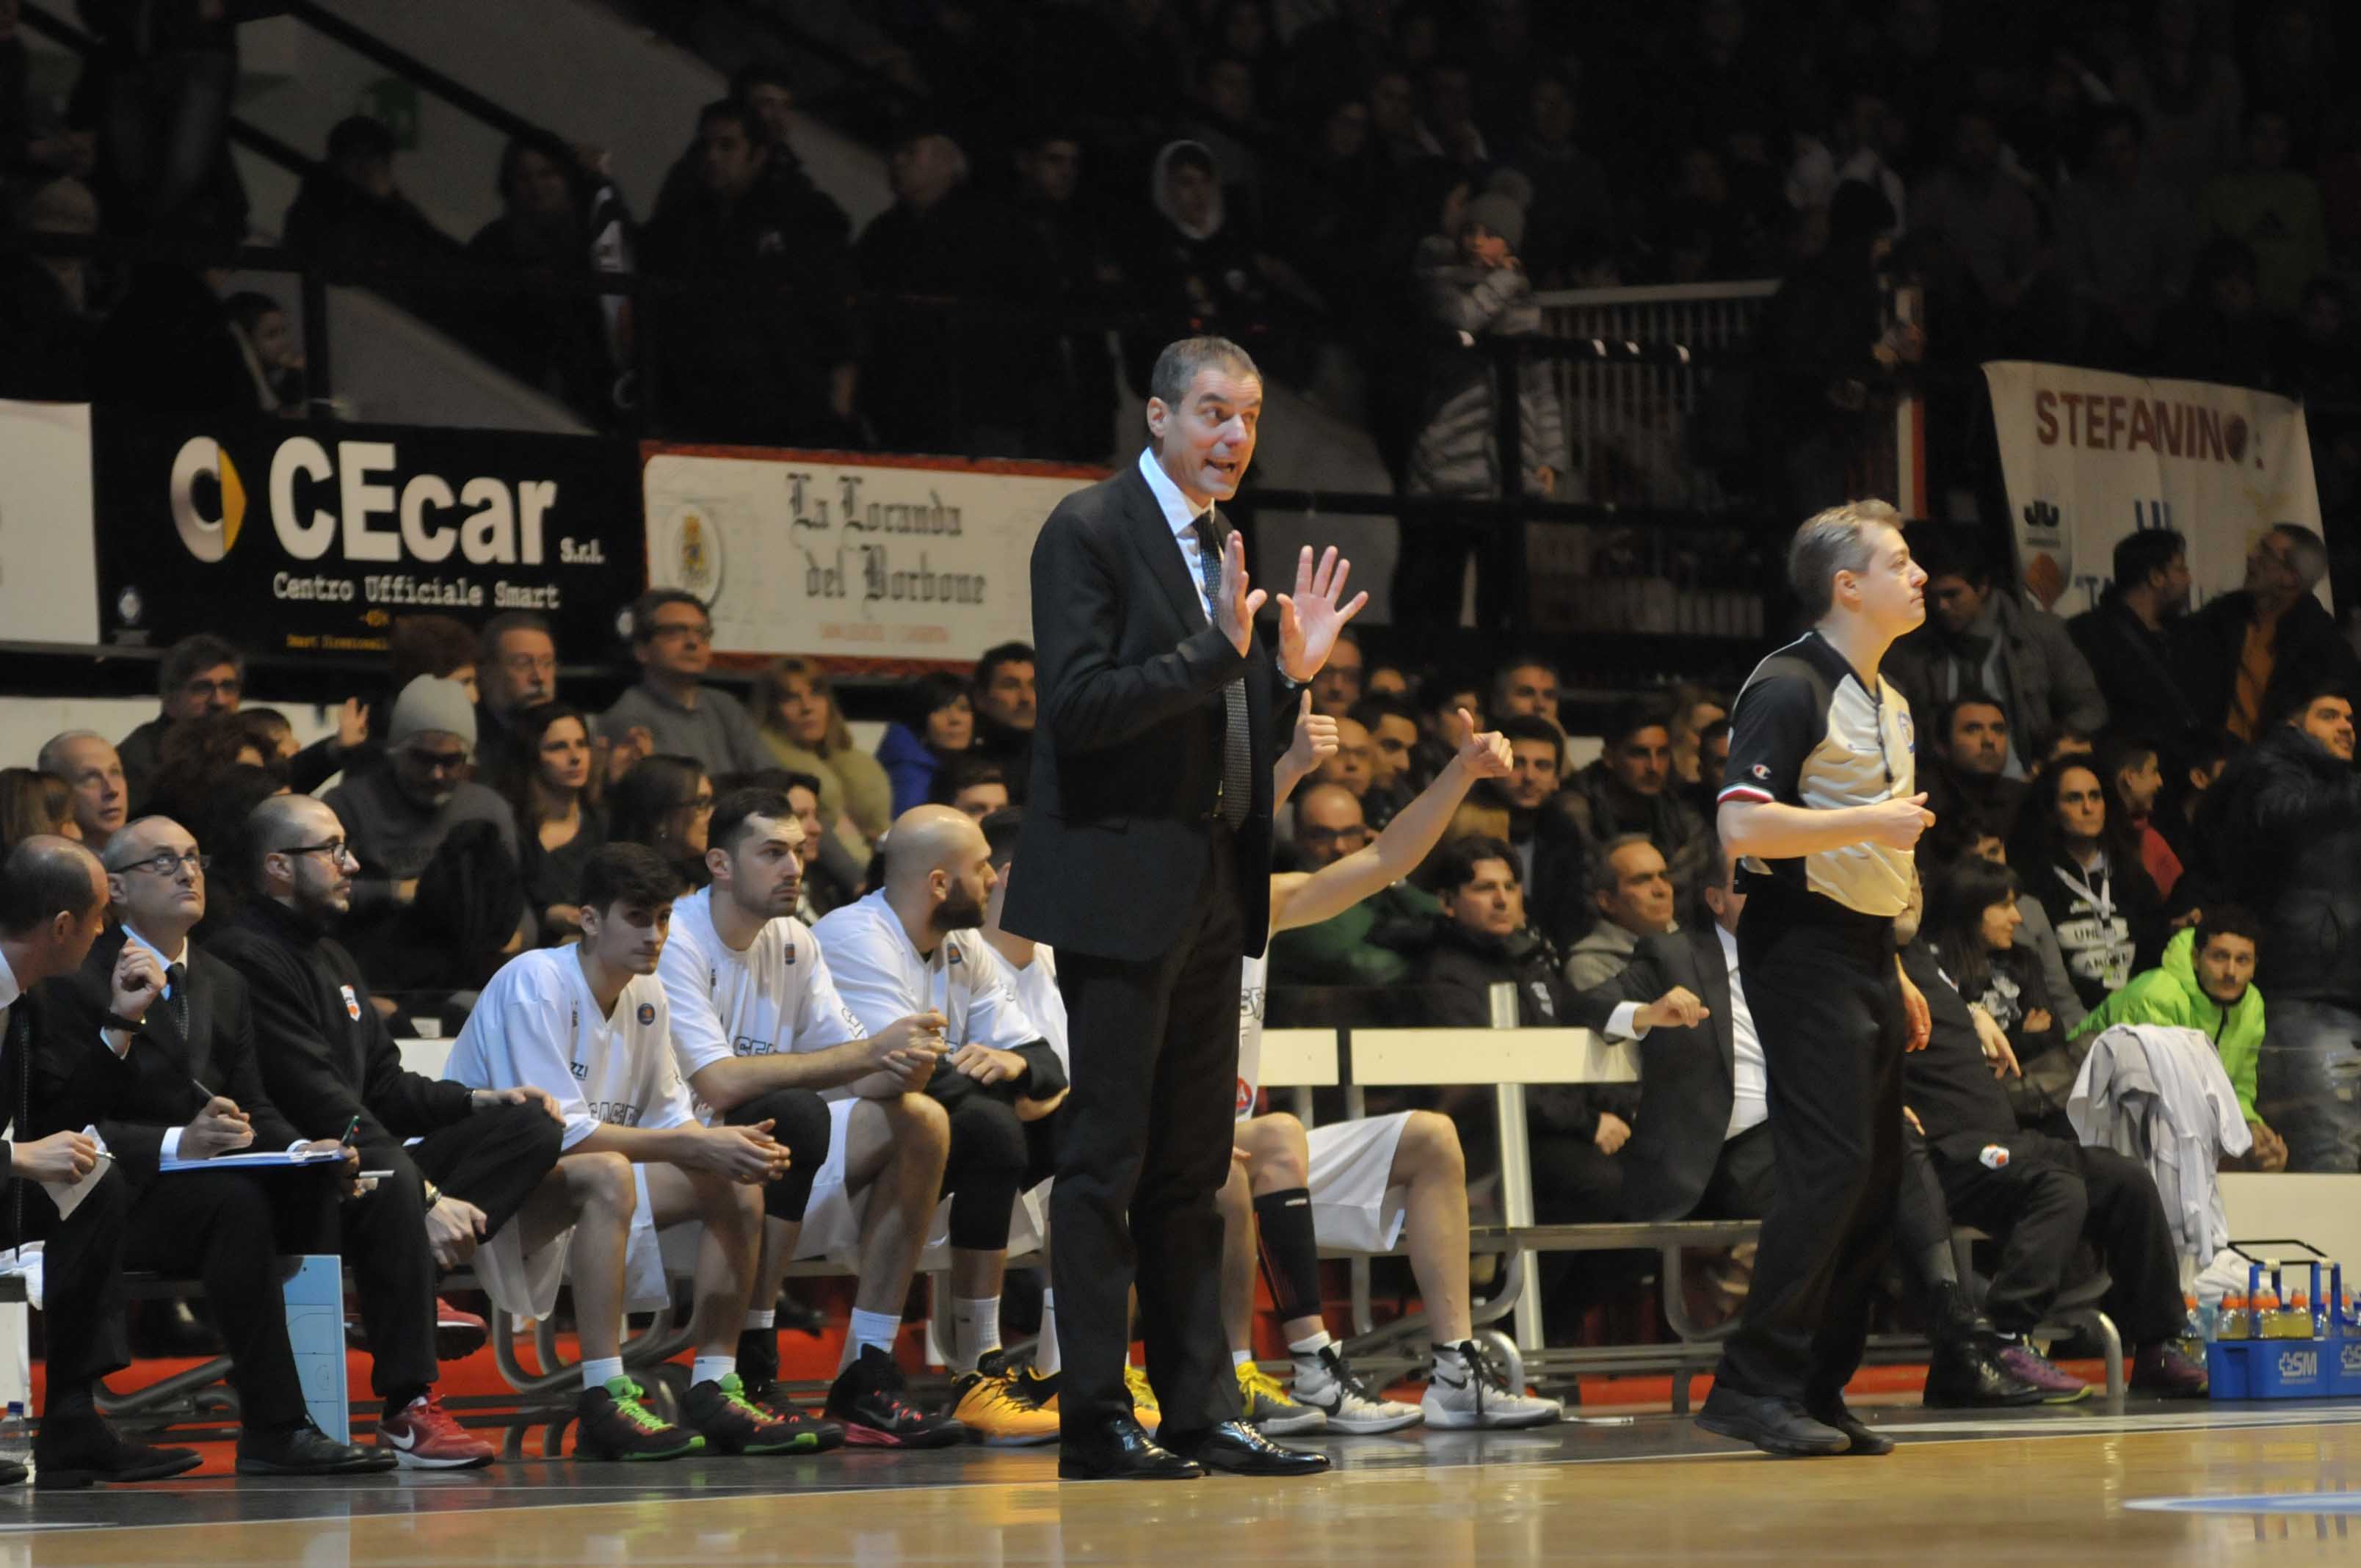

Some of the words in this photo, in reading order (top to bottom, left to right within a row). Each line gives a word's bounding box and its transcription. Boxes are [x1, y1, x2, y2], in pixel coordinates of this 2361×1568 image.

[269, 435, 558, 565] CEcar
[786, 472, 830, 534] La
[835, 476, 964, 537] Locanda
[272, 572, 355, 602] Centro
[363, 575, 485, 605] Ufficiale
[493, 580, 560, 610] Smart
[804, 542, 848, 598] del
[857, 543, 987, 606] Borbone
